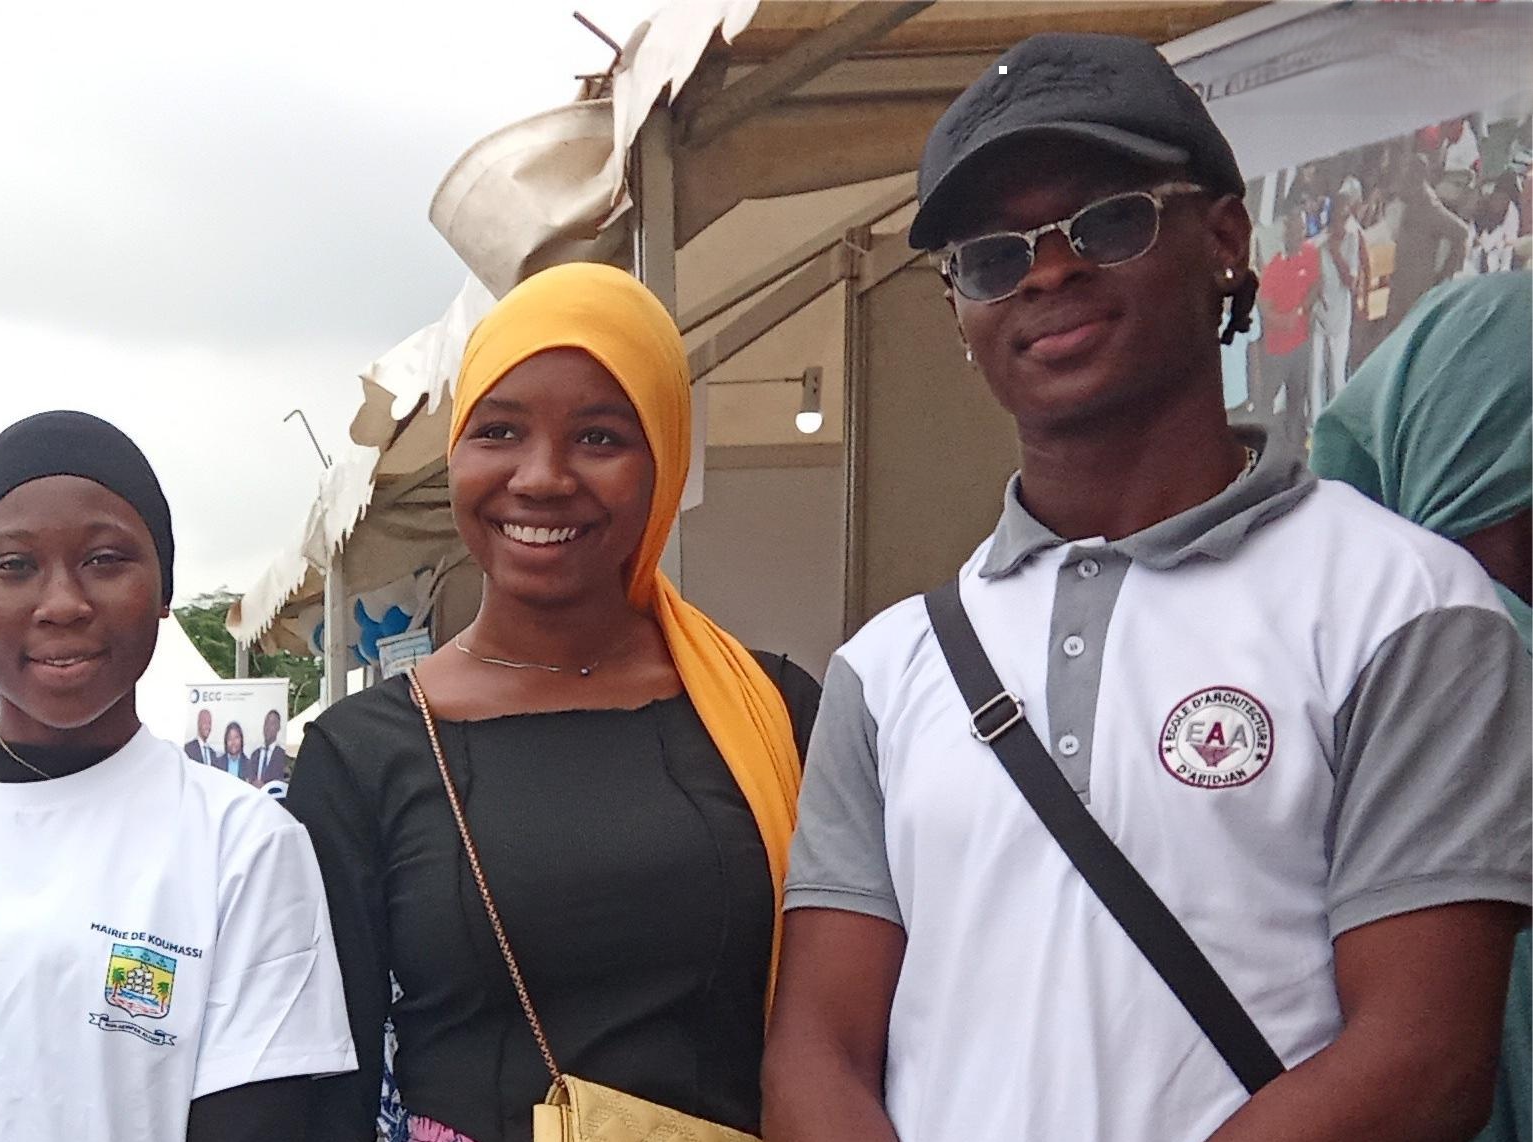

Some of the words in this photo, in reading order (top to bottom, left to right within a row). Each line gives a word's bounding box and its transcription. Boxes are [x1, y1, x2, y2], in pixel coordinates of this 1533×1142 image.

[1165, 705, 1192, 742] ECOLE
[1192, 692, 1268, 750] D'ARCHITECTURE
[1176, 764, 1248, 784] D'ABIDJAN
[90, 922, 129, 940] MAIRIE
[131, 932, 146, 941] DE
[148, 935, 203, 959] KOUMASSI
